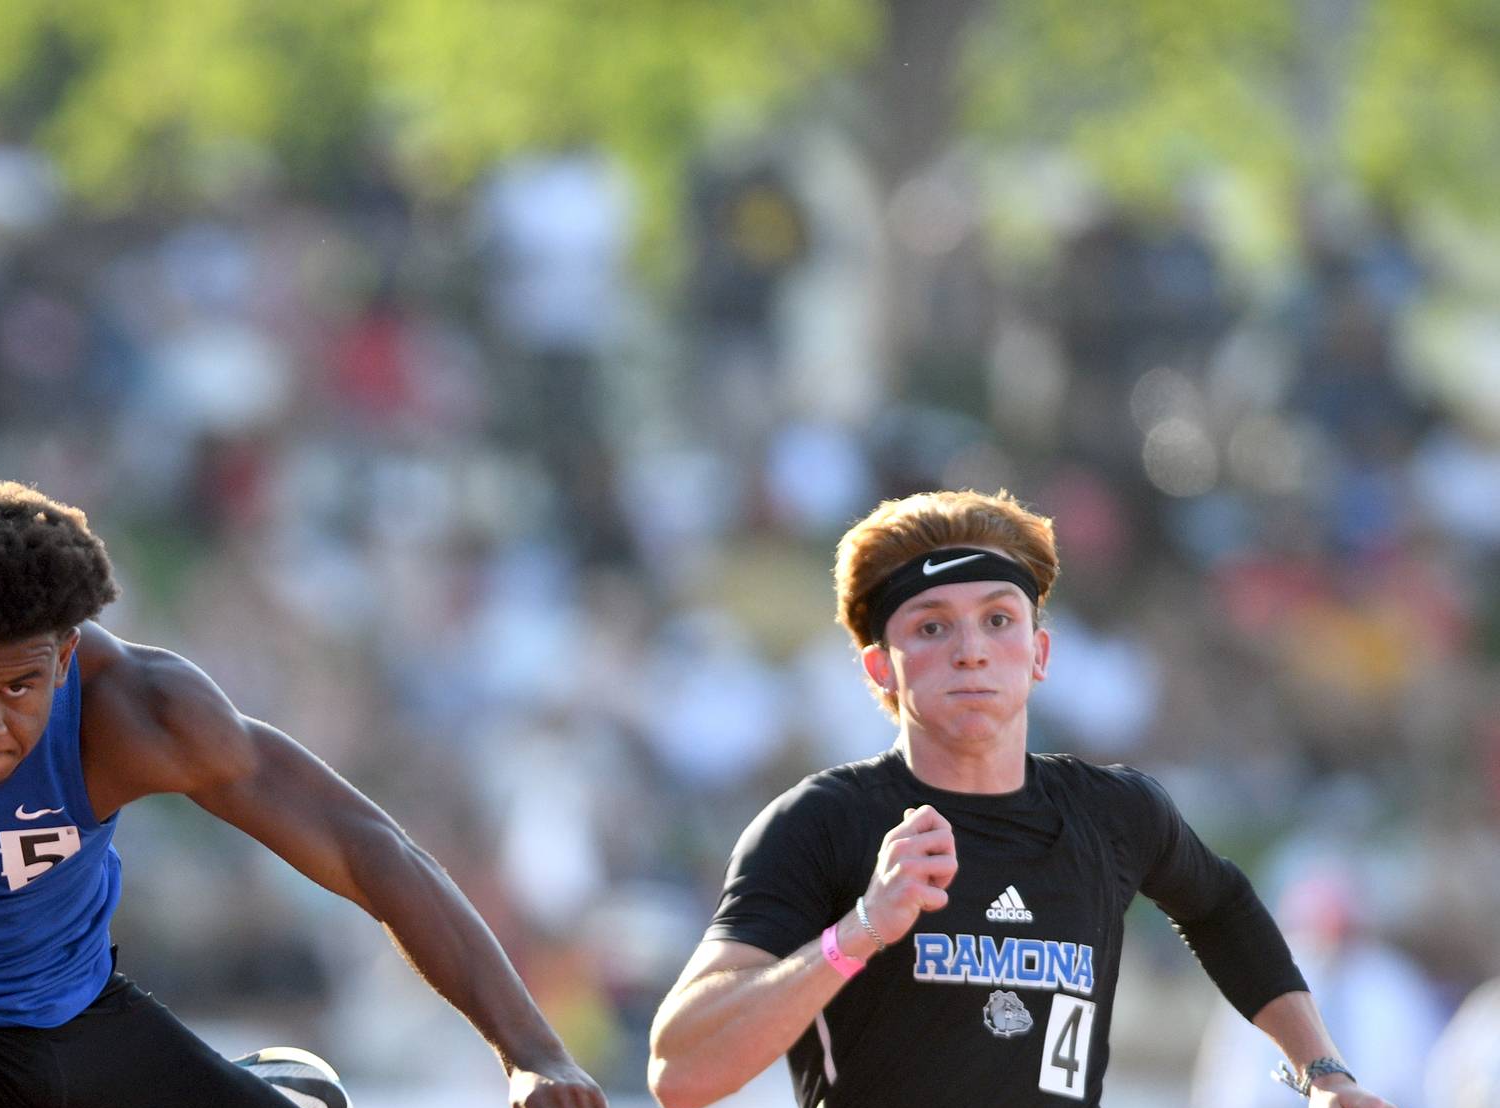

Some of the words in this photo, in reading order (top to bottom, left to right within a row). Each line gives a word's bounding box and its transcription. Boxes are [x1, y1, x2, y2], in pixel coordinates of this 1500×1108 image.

[19, 831, 65, 882] 5
[986, 906, 1034, 922] adidas
[913, 932, 1094, 996] RAMONA
[1050, 1003, 1085, 1089] 4
